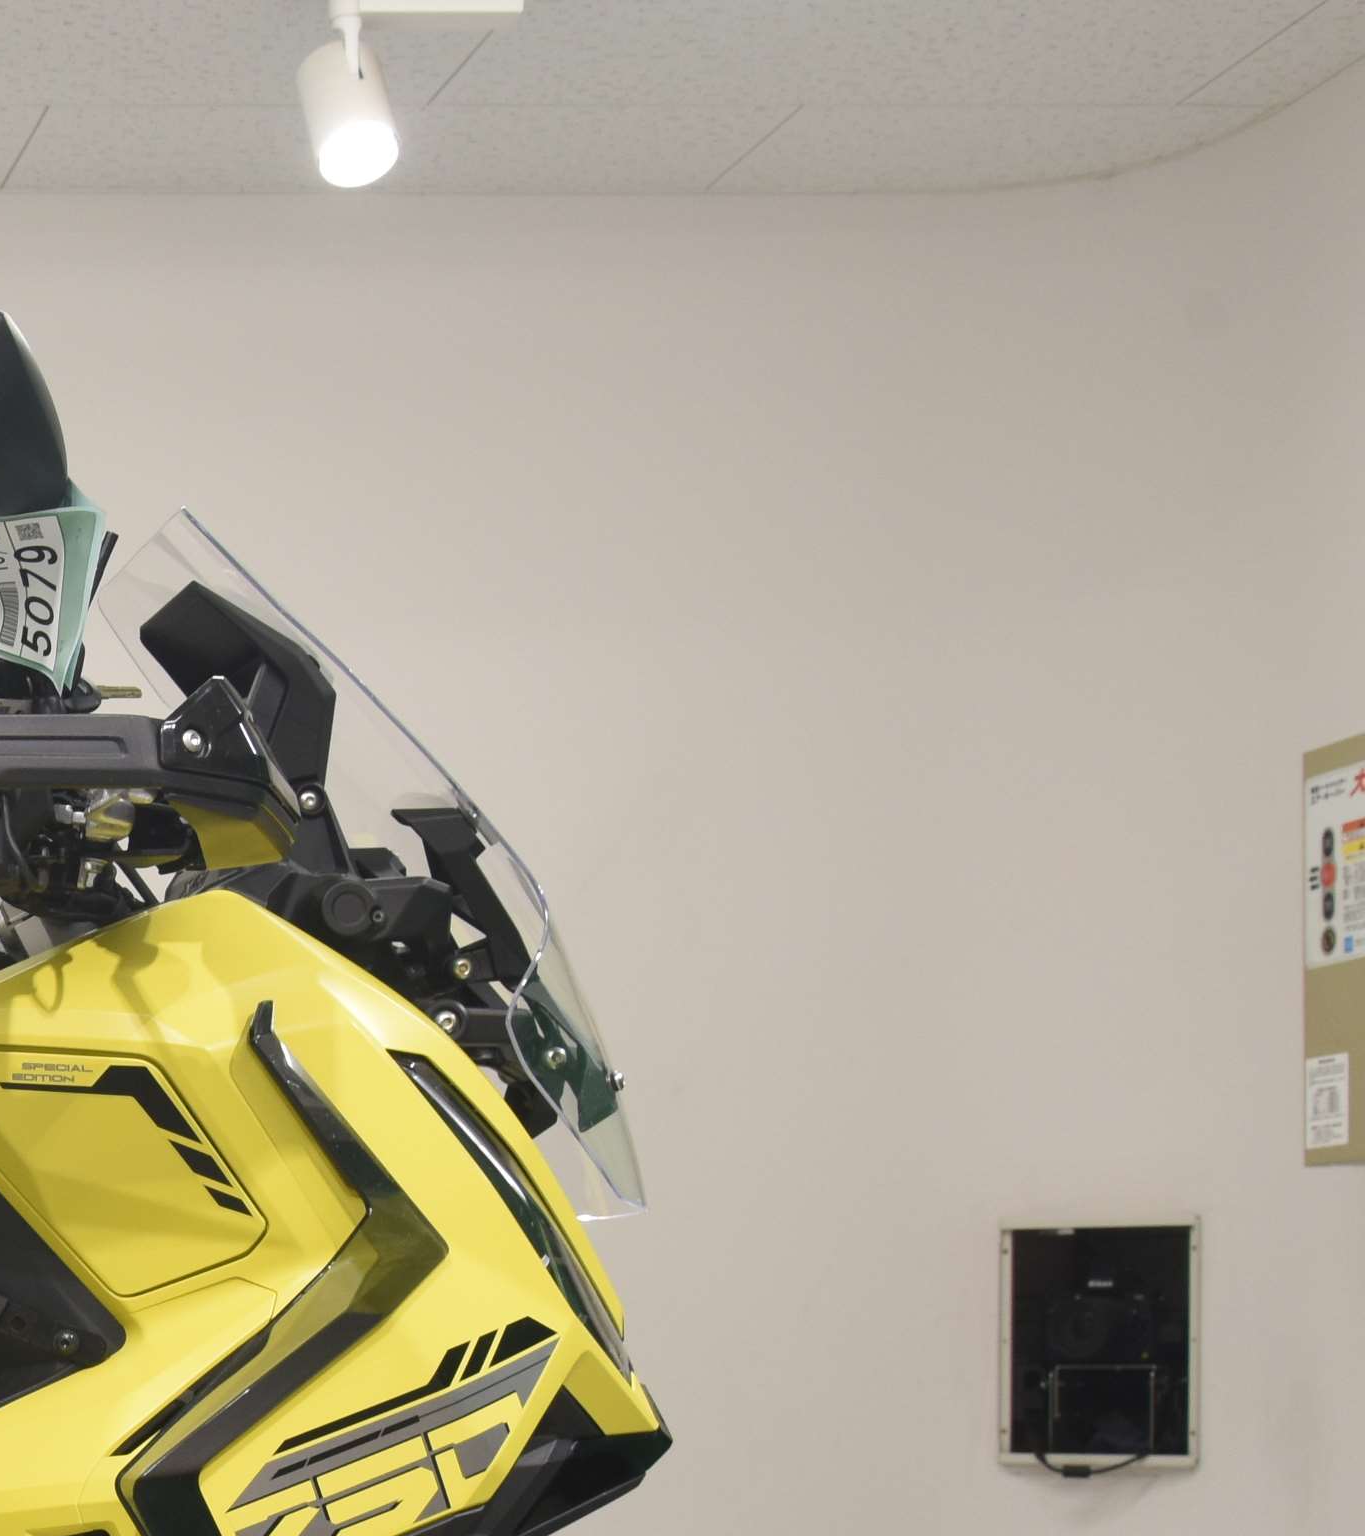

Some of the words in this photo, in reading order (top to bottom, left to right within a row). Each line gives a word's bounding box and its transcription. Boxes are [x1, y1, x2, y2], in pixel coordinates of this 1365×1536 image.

[13, 545, 59, 657] 5079
[21, 1061, 94, 1073] SPECIAL
[11, 1073, 76, 1083] EDITION
